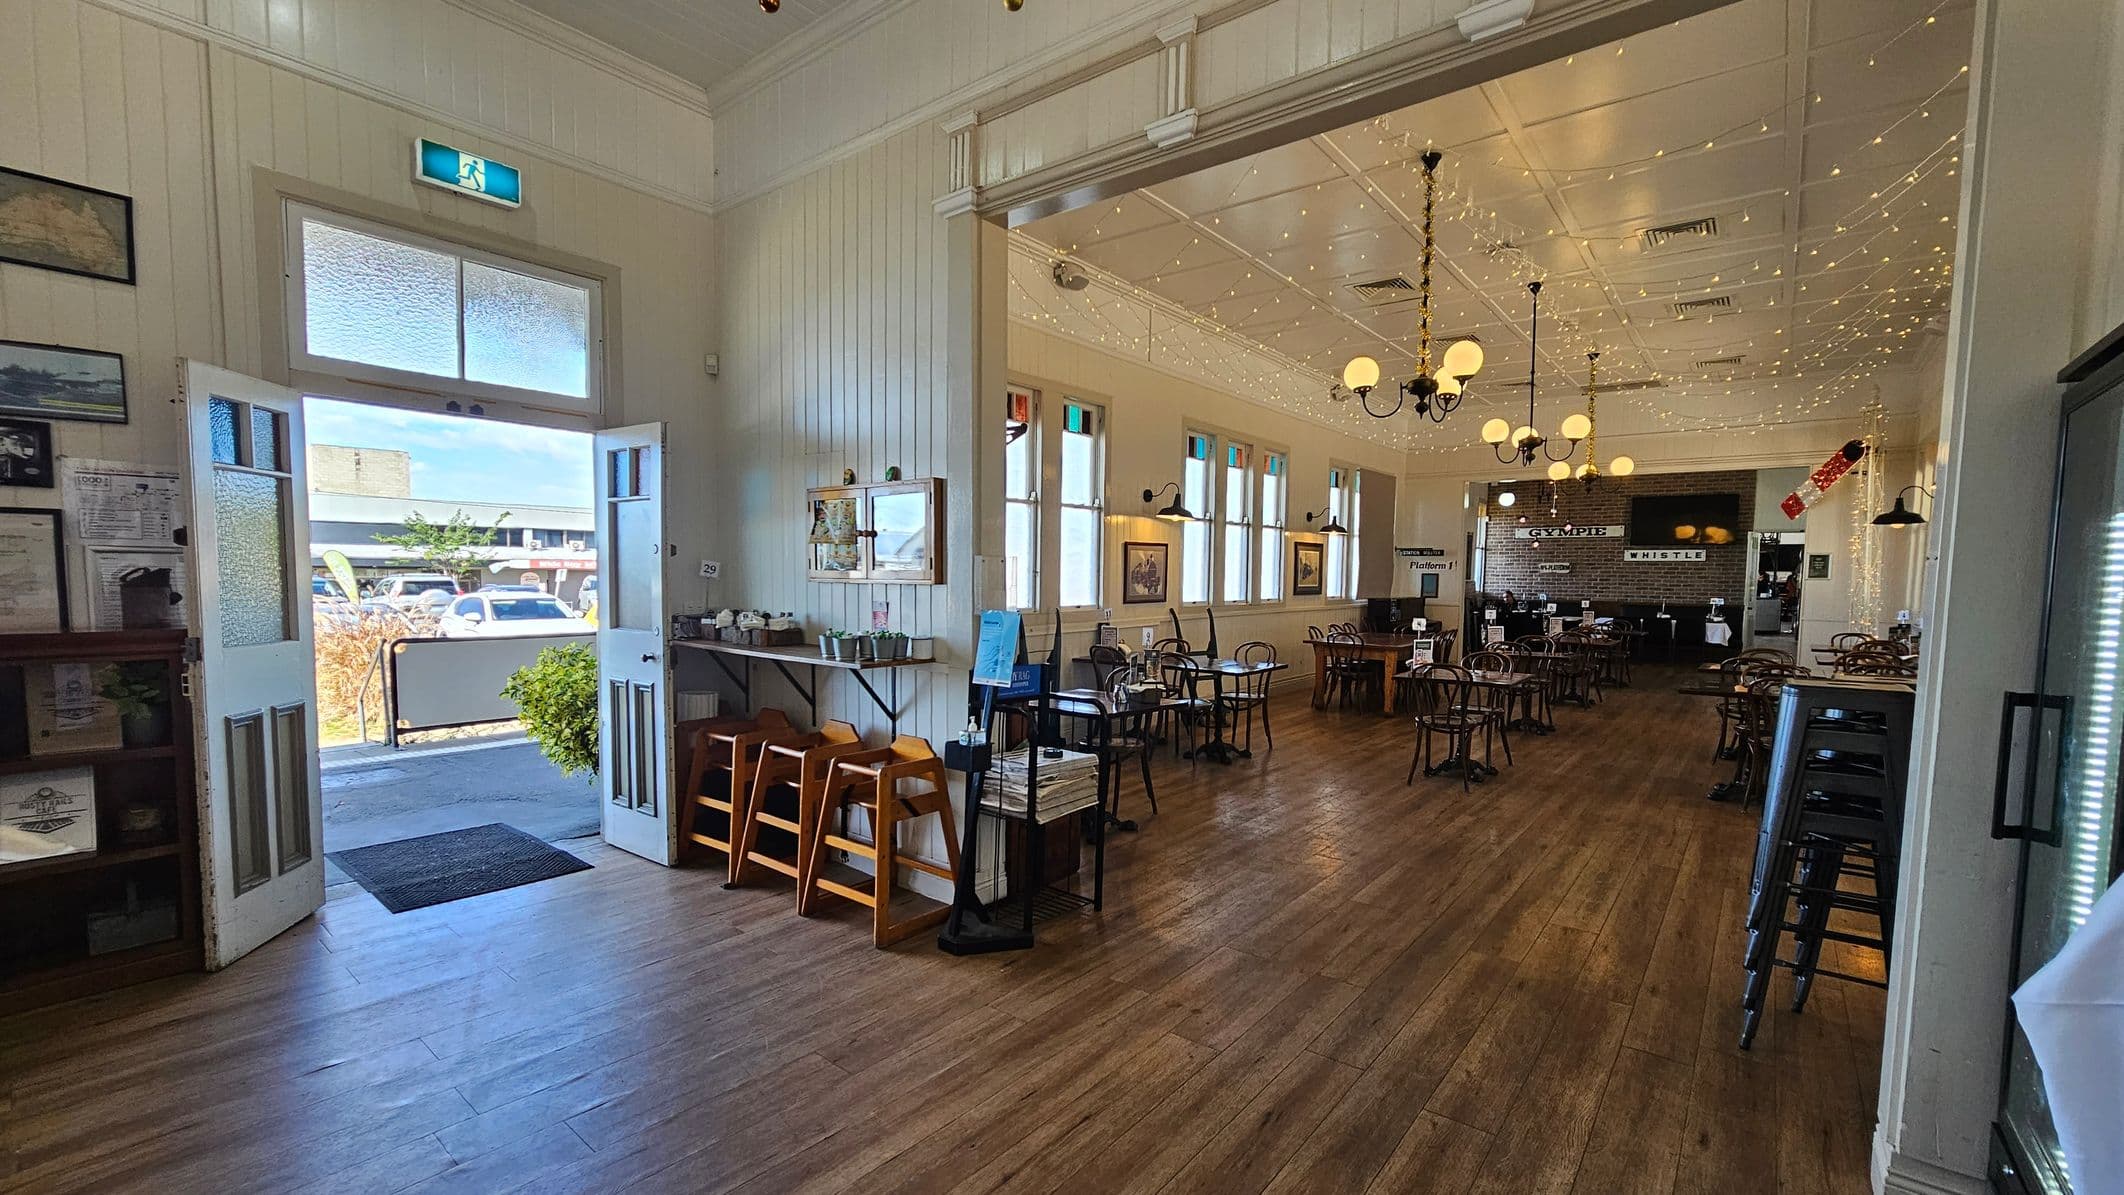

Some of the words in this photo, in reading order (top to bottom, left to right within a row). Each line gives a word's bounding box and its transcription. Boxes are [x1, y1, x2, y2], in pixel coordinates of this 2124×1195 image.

[1528, 527, 1607, 538] GYMPIE
[1629, 551, 1703, 560] WHISTLE
[704, 563, 717, 575] 29
[1409, 561, 1447, 570] Platform
[19, 800, 47, 810] RUSTY
